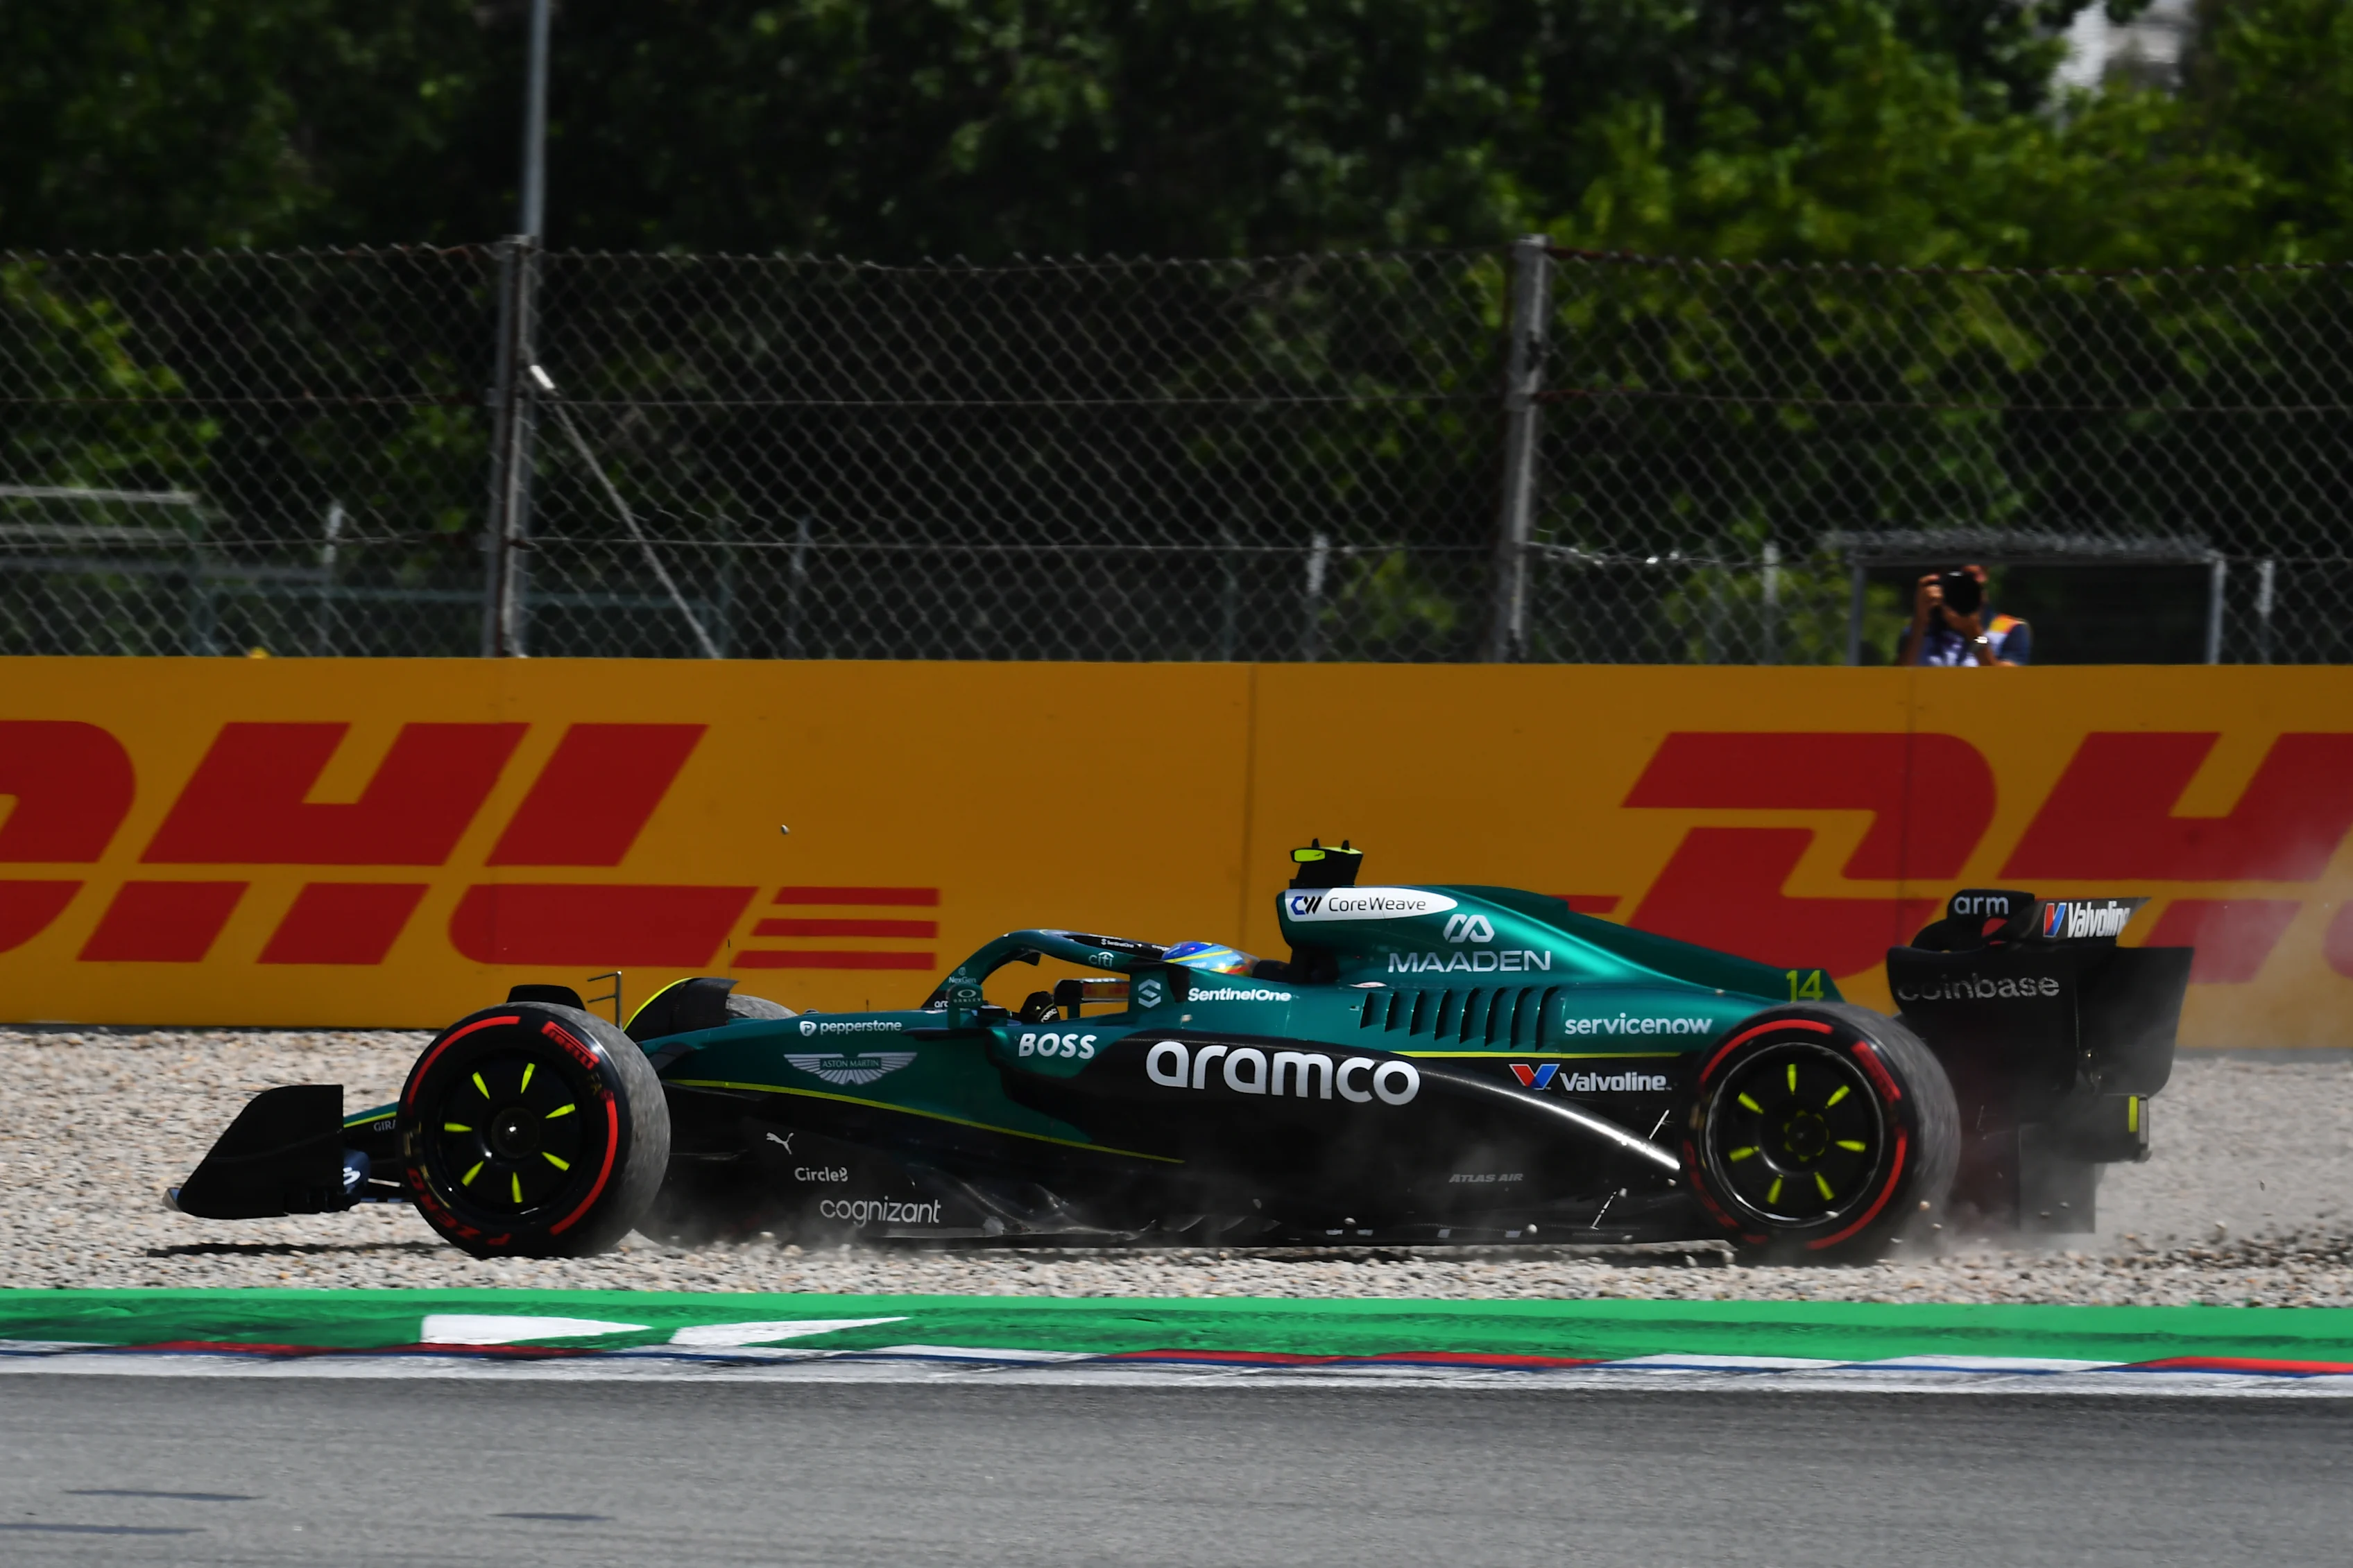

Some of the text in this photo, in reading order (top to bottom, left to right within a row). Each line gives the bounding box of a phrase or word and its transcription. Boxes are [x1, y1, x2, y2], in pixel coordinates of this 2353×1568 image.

[1621, 732, 2353, 985] DH
[1329, 897, 1426, 913] CoreWeave
[1953, 895, 2010, 915] arm
[1088, 951, 1115, 968] citi
[1387, 950, 1551, 973] MAADEN
[1187, 987, 1292, 1002] SentinelOne
[1786, 969, 1824, 1003] 14
[1897, 972, 2061, 1001] coinbase
[820, 1020, 902, 1035] pepperstone
[1564, 1013, 1714, 1035] servicenow
[1018, 1033, 1097, 1059] BOSS
[822, 1058, 880, 1068] ASTON MARTIN
[1145, 1040, 1421, 1106] aramco
[1559, 1071, 1668, 1092] Valvoline
[1448, 1173, 1524, 1183] ATLAS AIR
[820, 1195, 942, 1228] cognizant
